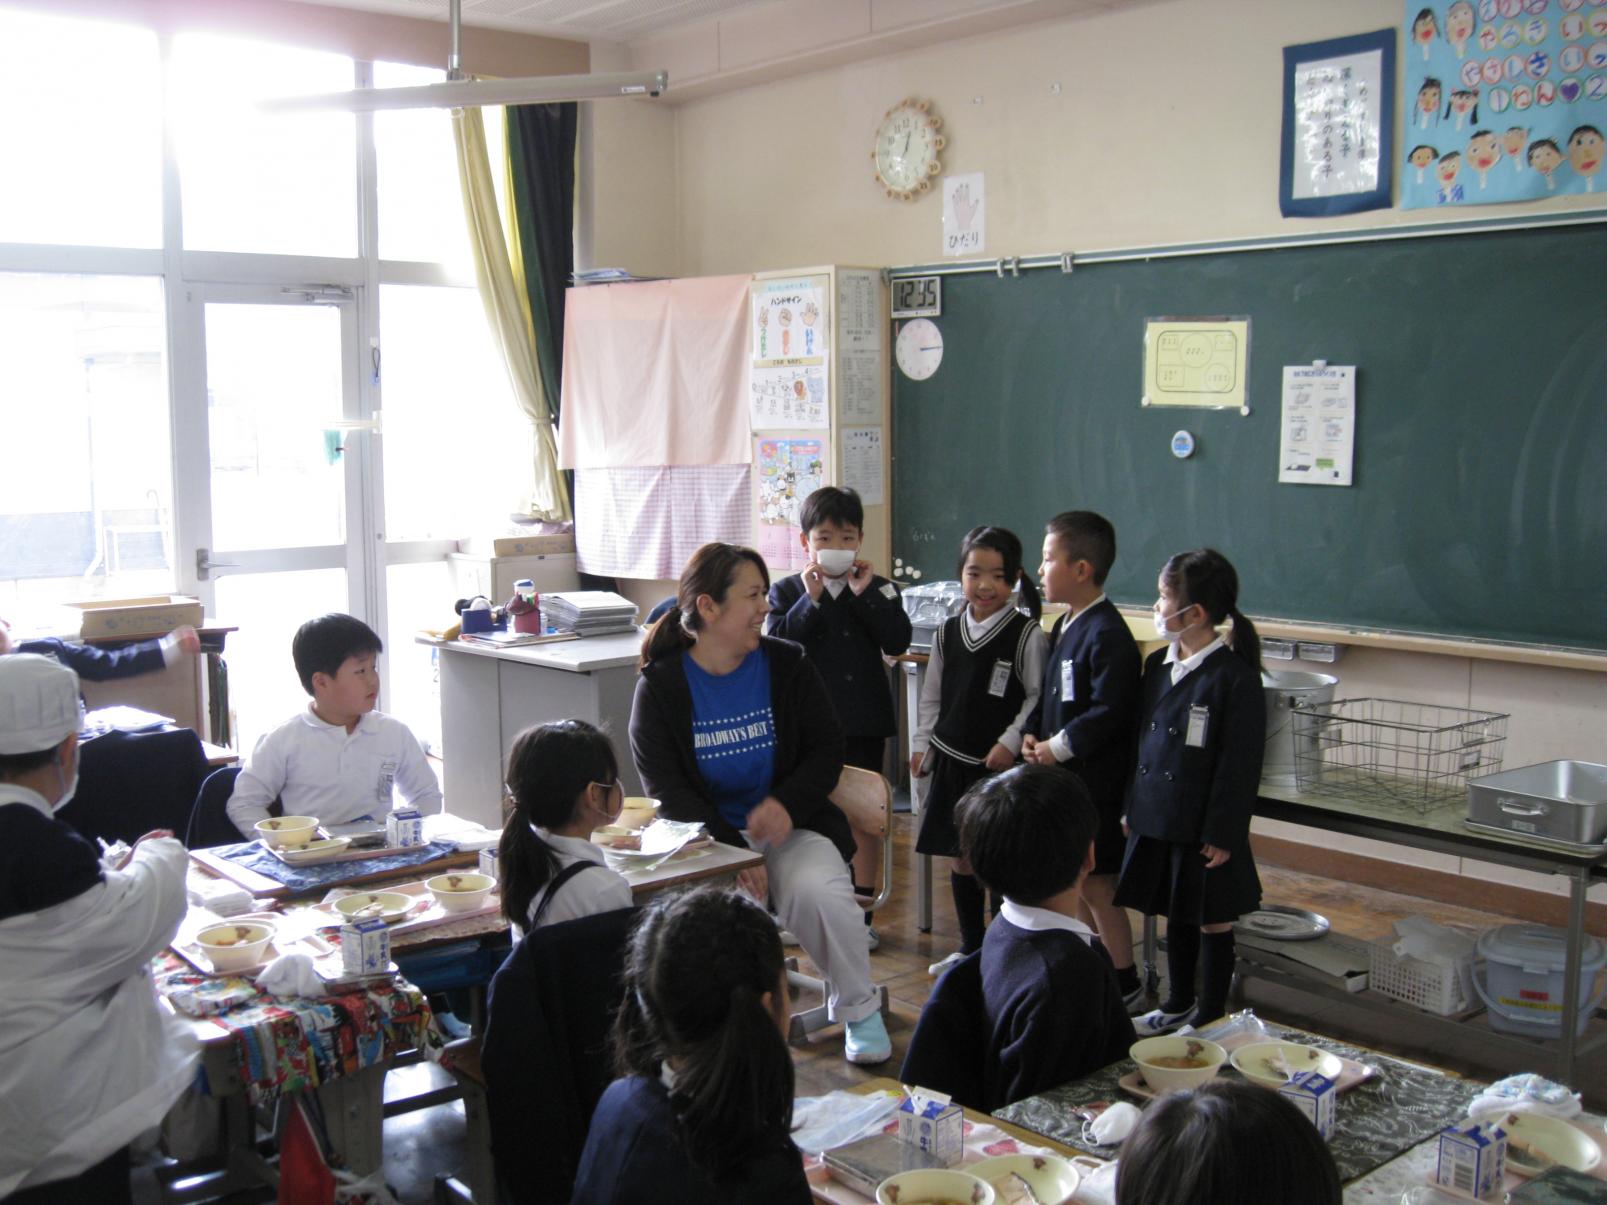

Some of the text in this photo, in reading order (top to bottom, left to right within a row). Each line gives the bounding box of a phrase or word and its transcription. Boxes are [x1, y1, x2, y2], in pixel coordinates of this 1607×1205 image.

[949, 231, 979, 249] ひだり
[770, 296, 803, 306] ハンドサイン
[694, 721, 768, 748] BROADWAY'S BEST
